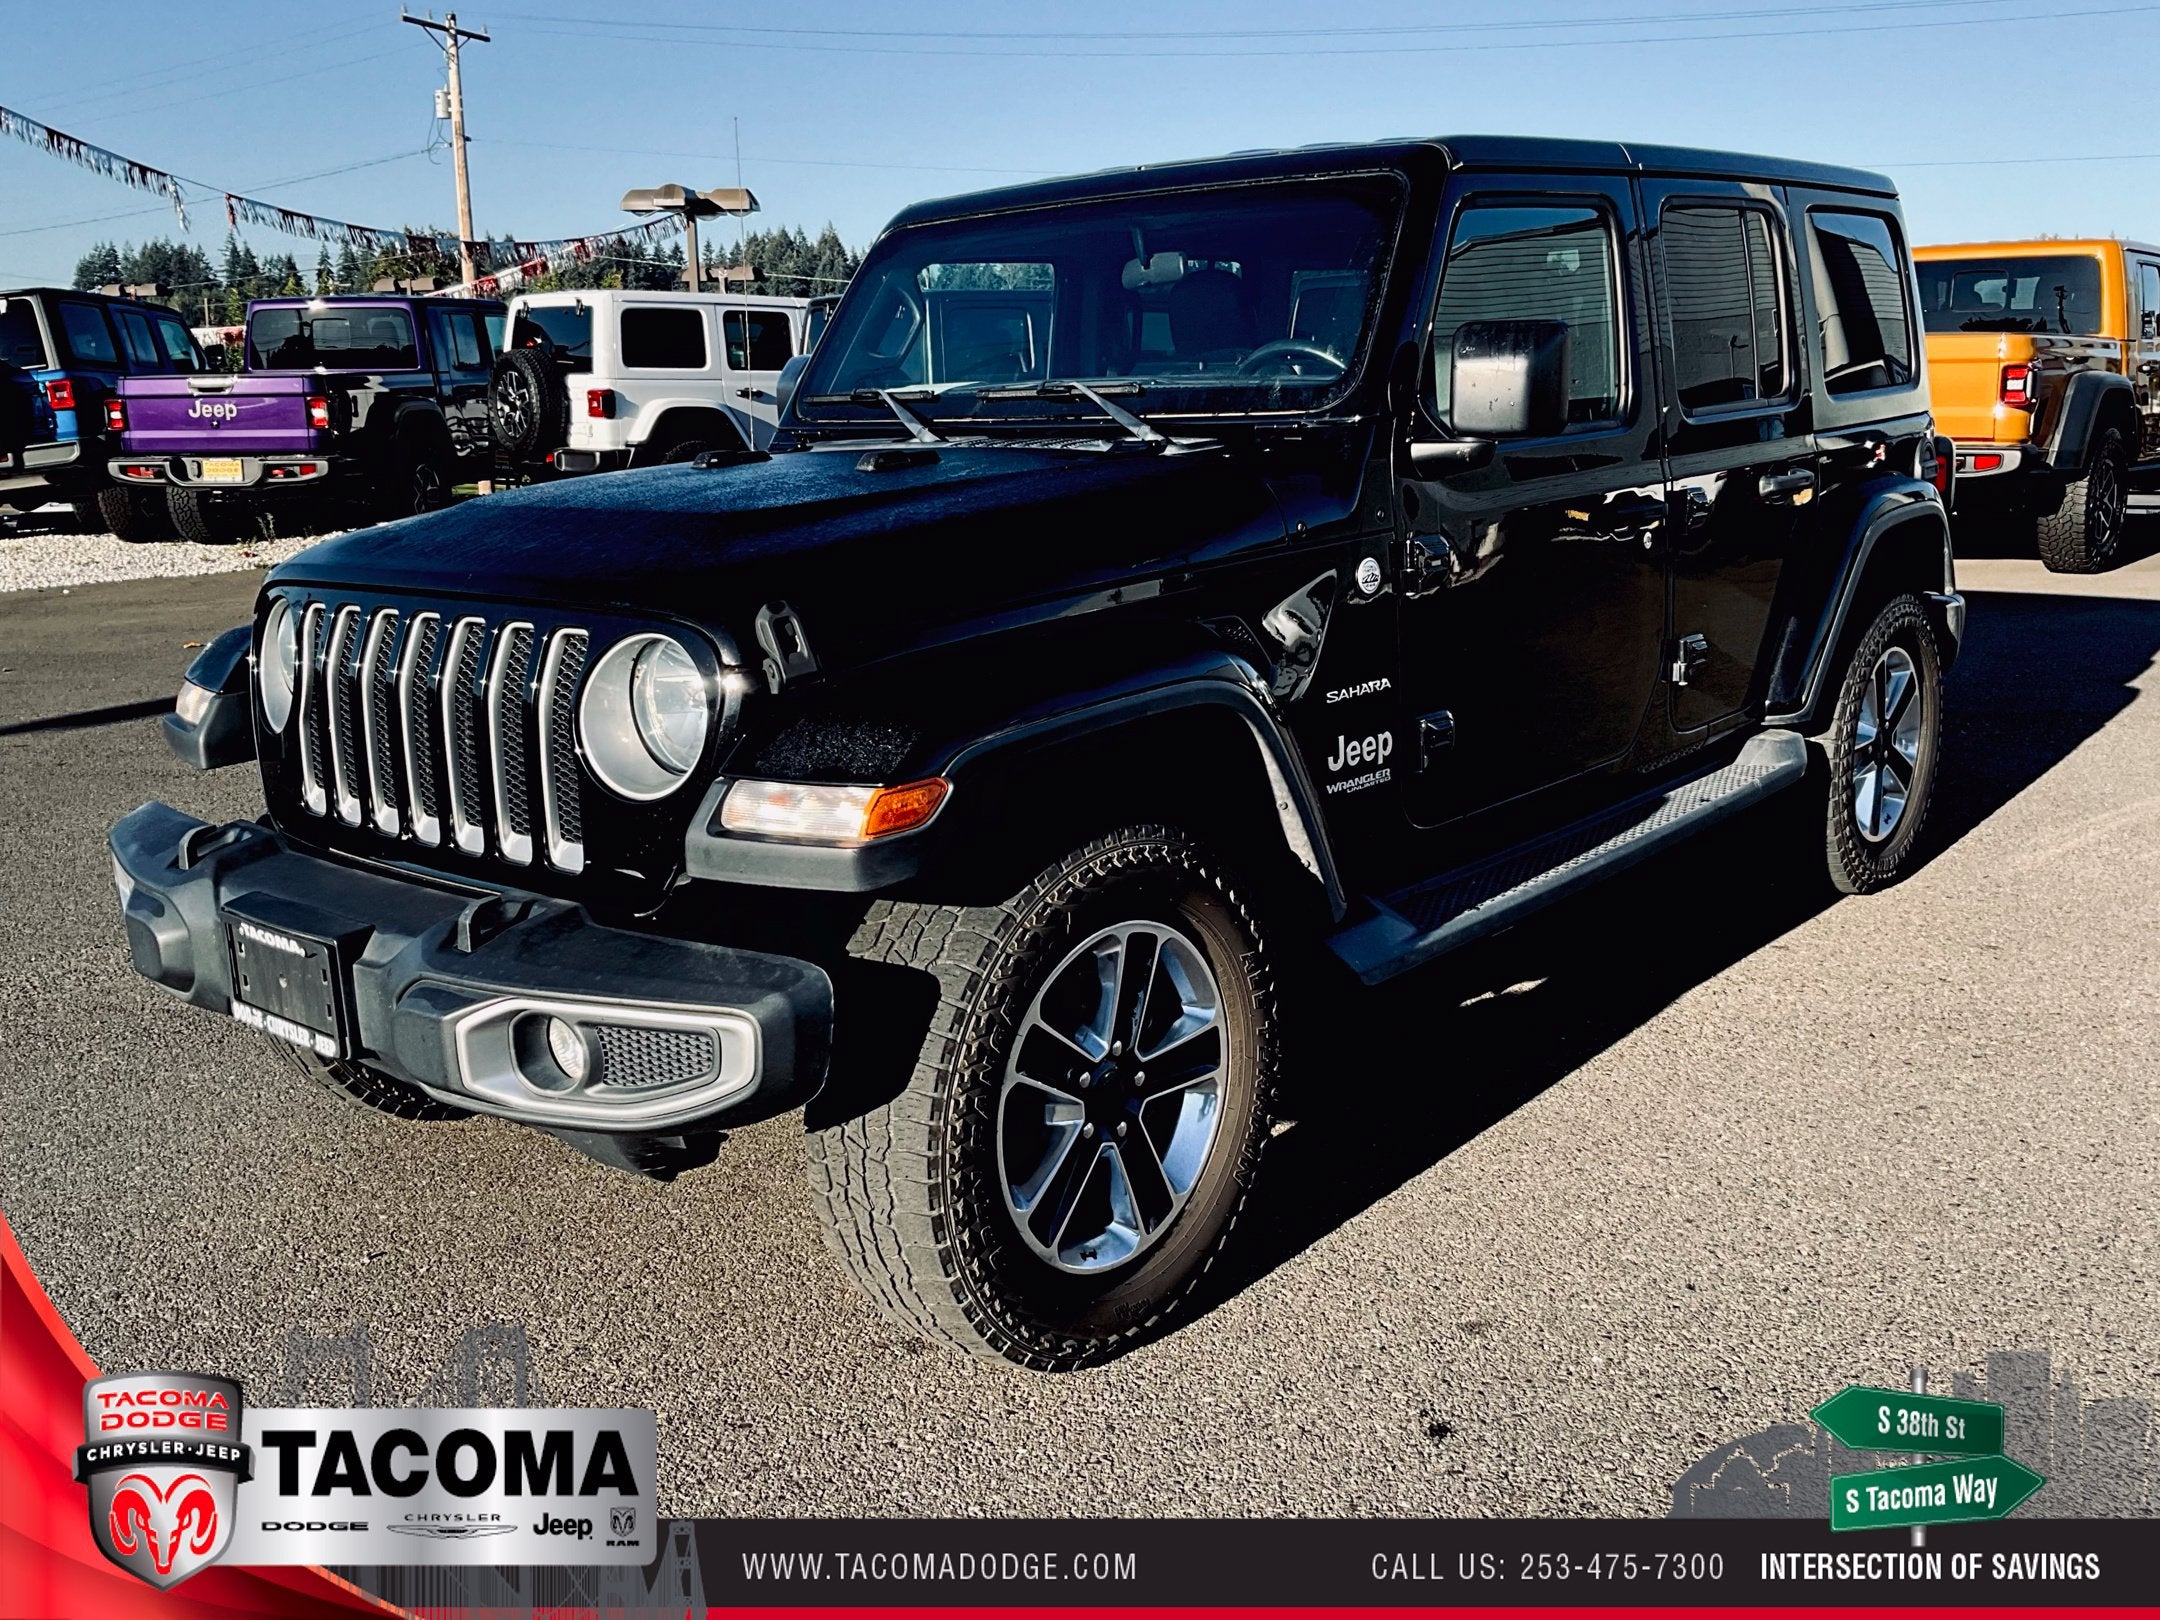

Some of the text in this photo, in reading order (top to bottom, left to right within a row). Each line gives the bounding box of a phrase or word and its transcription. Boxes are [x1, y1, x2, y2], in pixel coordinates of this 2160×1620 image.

[188, 398, 237, 421] Jeep
[1326, 678, 1391, 703] SAHARA
[1328, 731, 1392, 771] Jeep
[1326, 768, 1391, 794] WRANGLER
[1346, 776, 1391, 793] UNLIMITED
[241, 923, 301, 955] TACOMA
